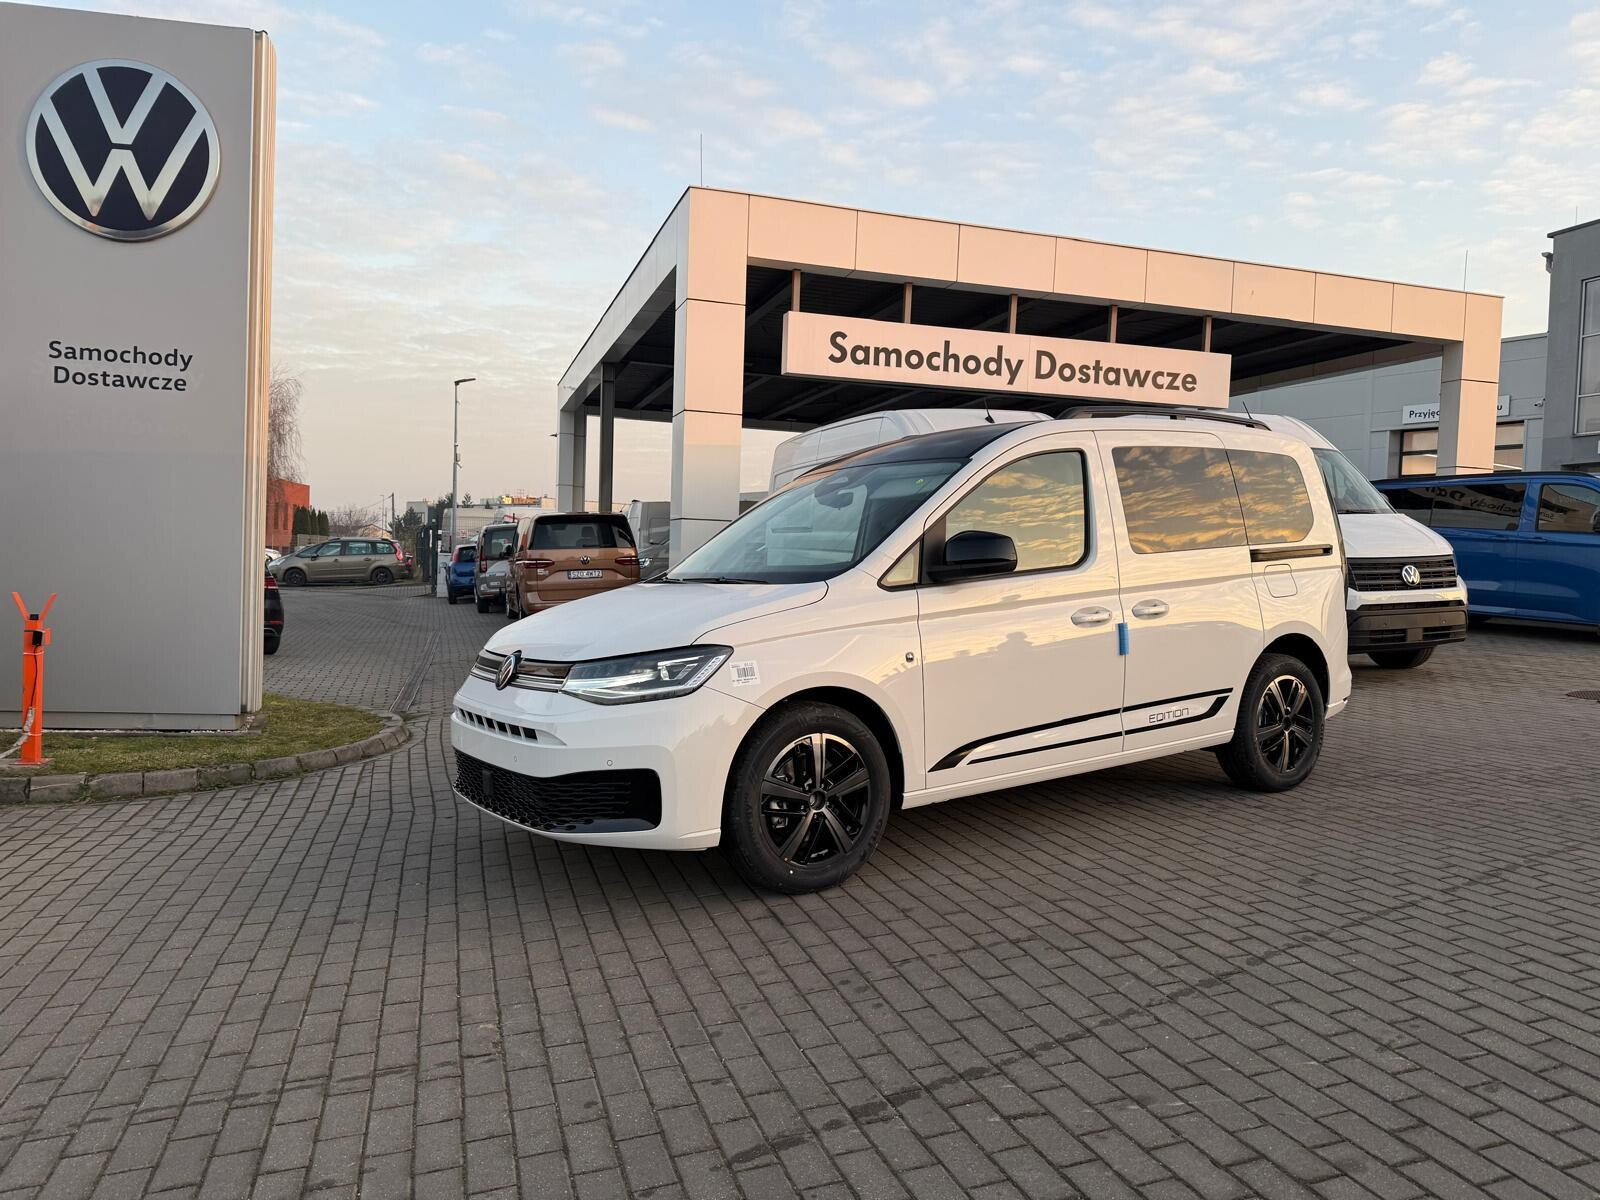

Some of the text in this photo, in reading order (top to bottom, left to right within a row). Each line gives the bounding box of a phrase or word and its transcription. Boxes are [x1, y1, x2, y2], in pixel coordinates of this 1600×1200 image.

[48, 340, 193, 372] Samochody
[827, 331, 1198, 393] Samochody Dostawcze
[53, 365, 188, 392] Dostawcze
[1148, 707, 1190, 724] EDITION
